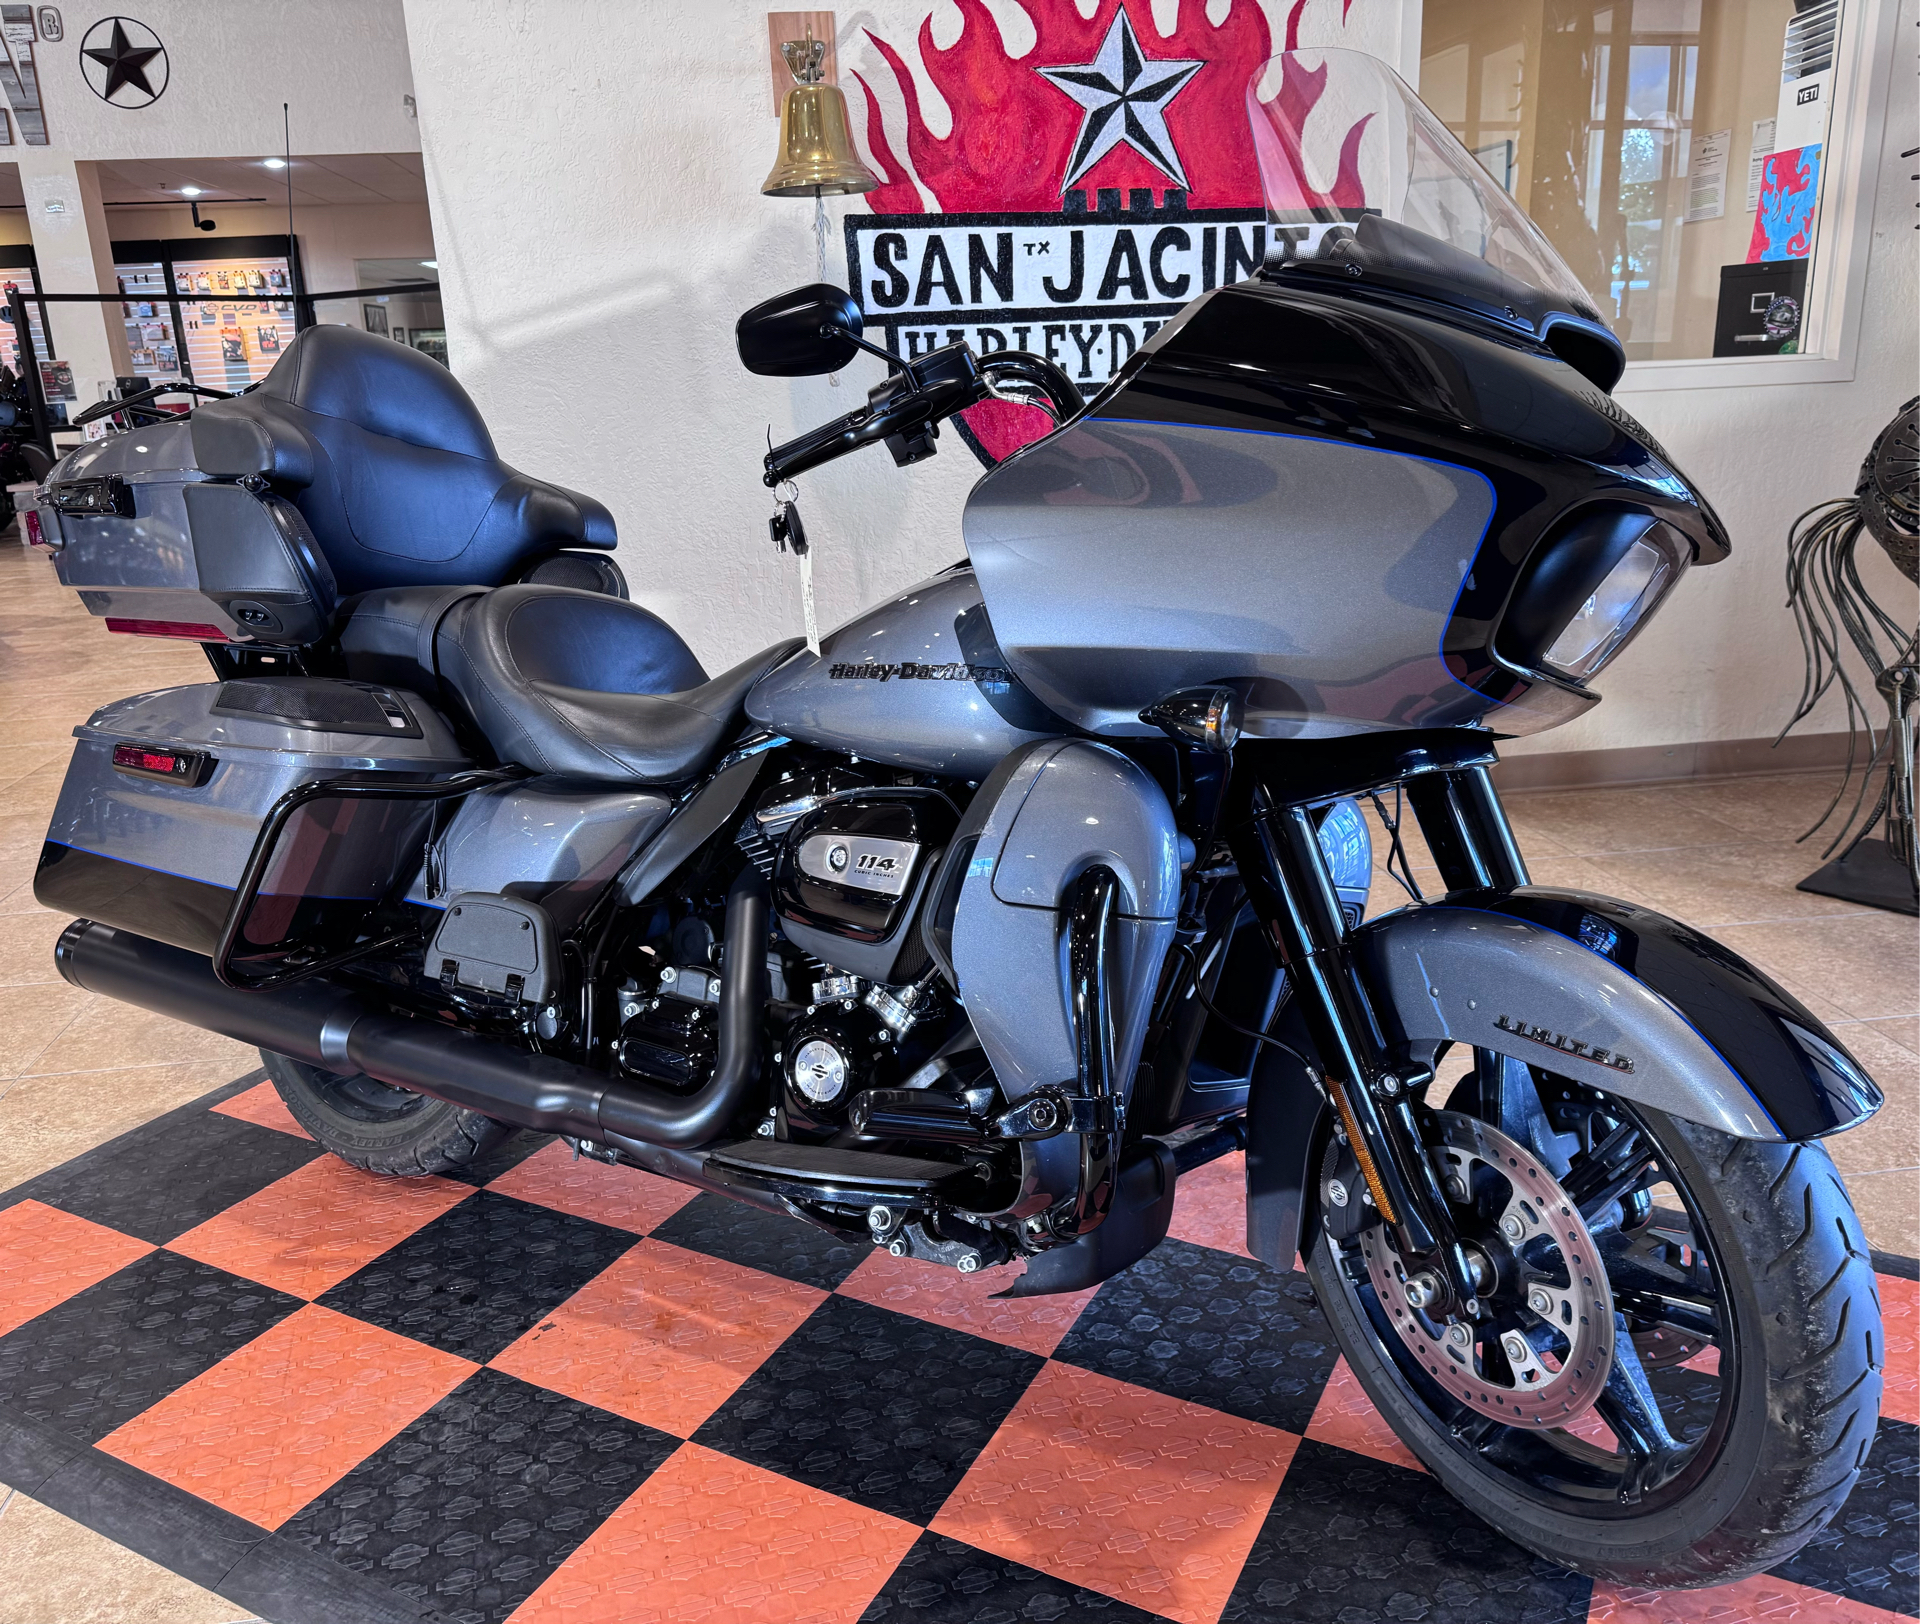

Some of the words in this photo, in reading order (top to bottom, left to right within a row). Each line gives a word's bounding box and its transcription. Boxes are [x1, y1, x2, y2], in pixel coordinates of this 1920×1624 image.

[1798, 86, 1818, 103] YETI
[871, 230, 1015, 308] SAN
[1023, 240, 1051, 256] TX
[855, 853, 898, 874] 114
[1494, 1013, 1636, 1073] LIMITED
